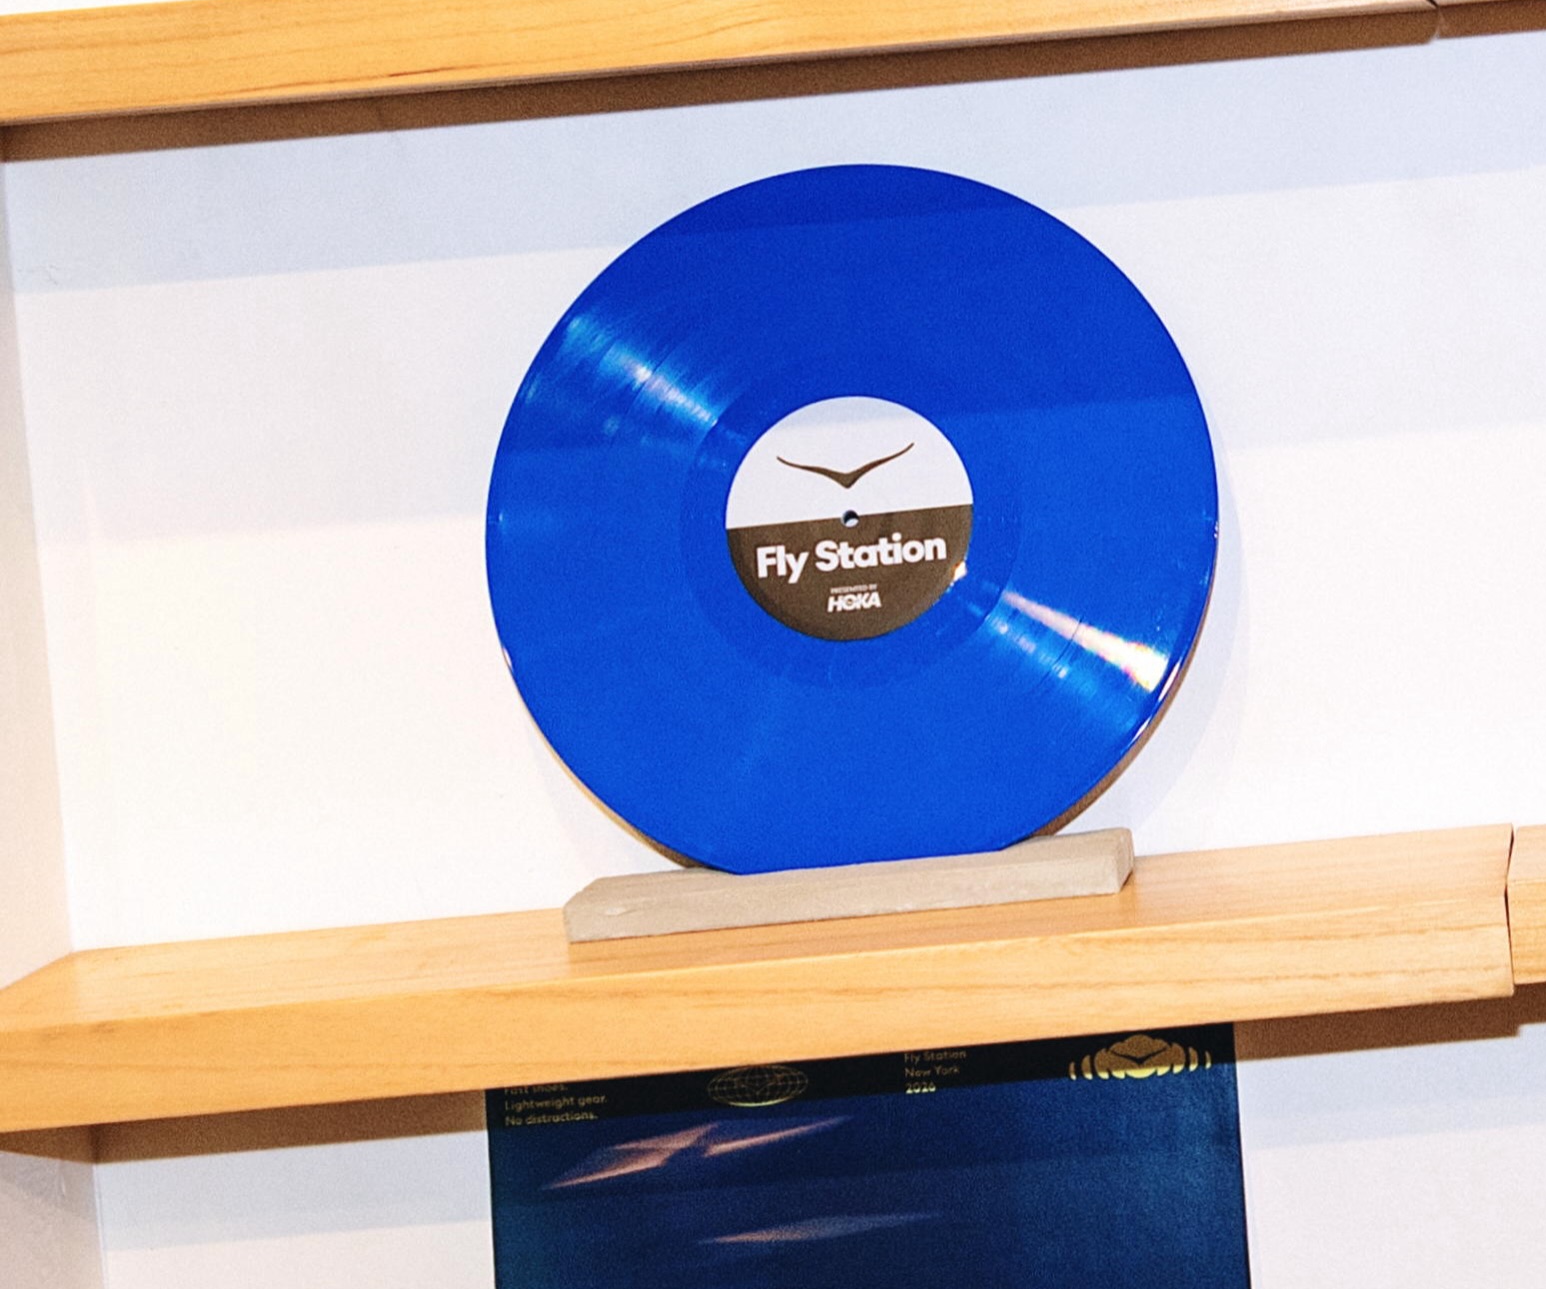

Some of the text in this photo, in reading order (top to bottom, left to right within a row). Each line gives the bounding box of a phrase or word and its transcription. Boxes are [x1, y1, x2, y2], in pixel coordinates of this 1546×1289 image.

[756, 532, 948, 584] Fly Station
[827, 591, 882, 613] HOKA
[505, 1097, 574, 1112] Lightweight
